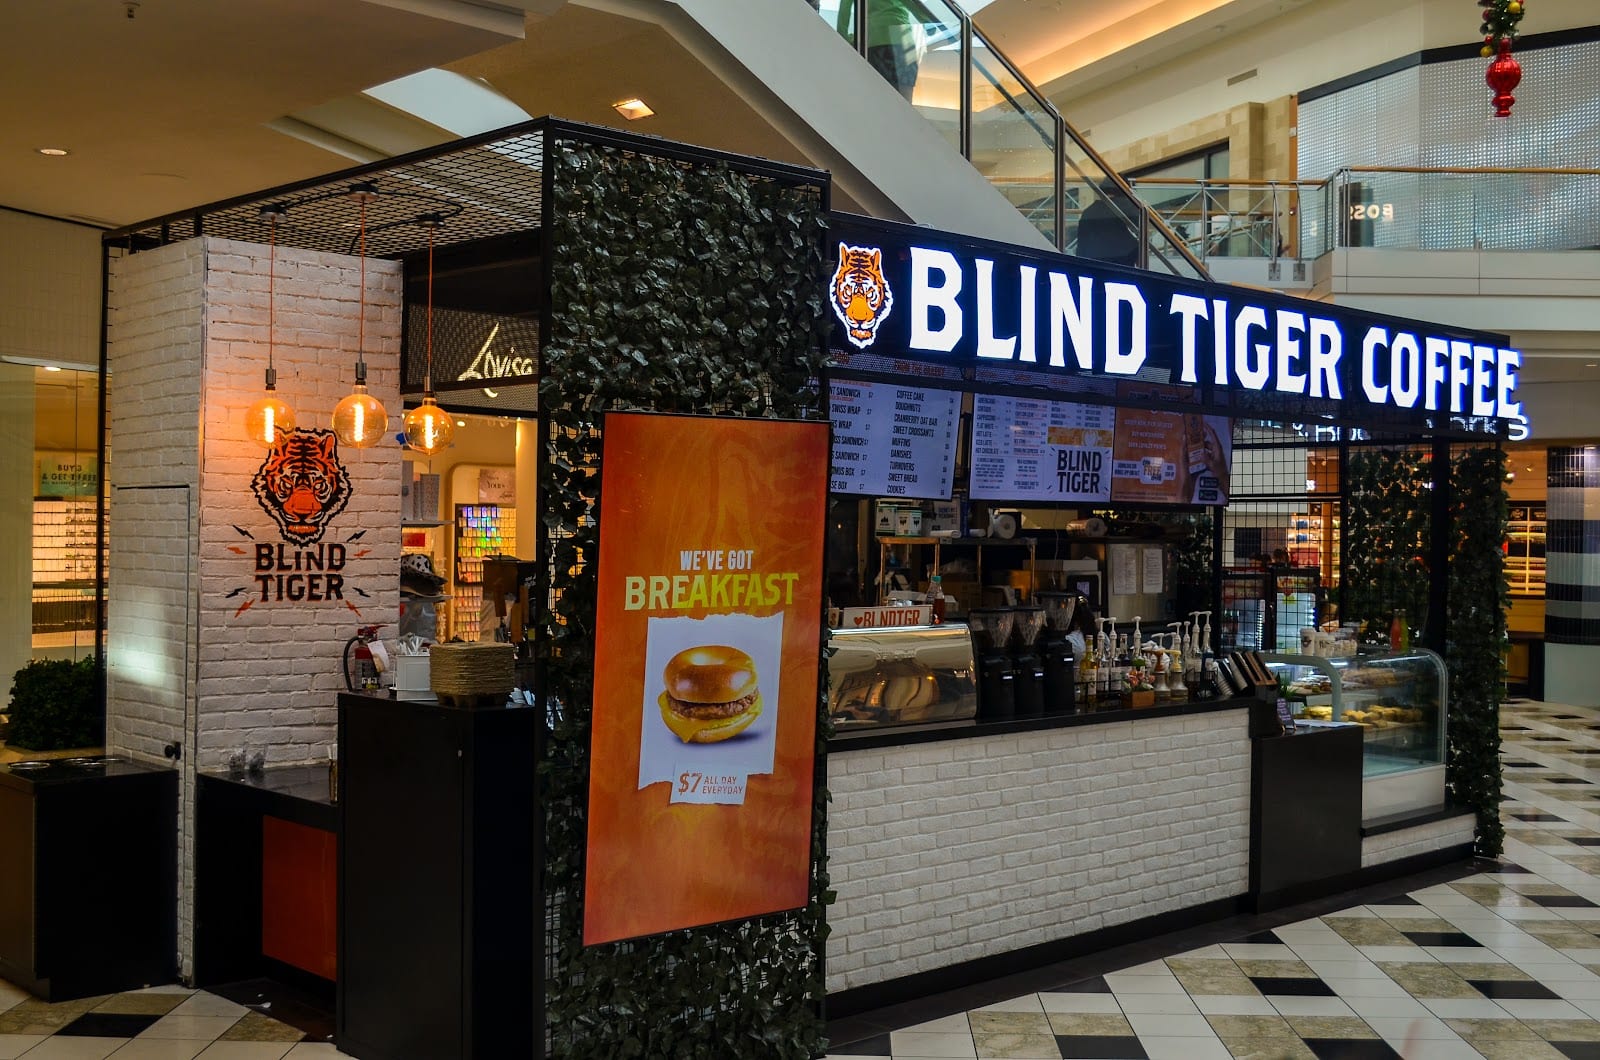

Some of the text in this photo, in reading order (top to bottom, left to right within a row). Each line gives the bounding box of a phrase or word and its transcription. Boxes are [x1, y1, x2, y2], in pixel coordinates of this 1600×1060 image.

[909, 246, 1522, 419] BLIND TIGER COFFEE
[896, 390, 912, 400] COFFEE
[894, 413, 919, 424] CRANBERRY
[893, 426, 908, 434] SWEET
[835, 451, 859, 461] SANDWICH
[1057, 450, 1102, 472] BLIND
[888, 473, 903, 481] SWEET
[1057, 472, 1099, 493] TIGER
[887, 485, 906, 494] COOKIES
[255, 543, 346, 572] BLIND
[680, 550, 754, 571] WE'VE GOT
[255, 573, 344, 602] TIGER
[624, 573, 799, 610] BREAKFAST
[678, 770, 702, 796] $7
[704, 775, 737, 785] ALL DAY
[702, 785, 743, 795] EVERYDAY
